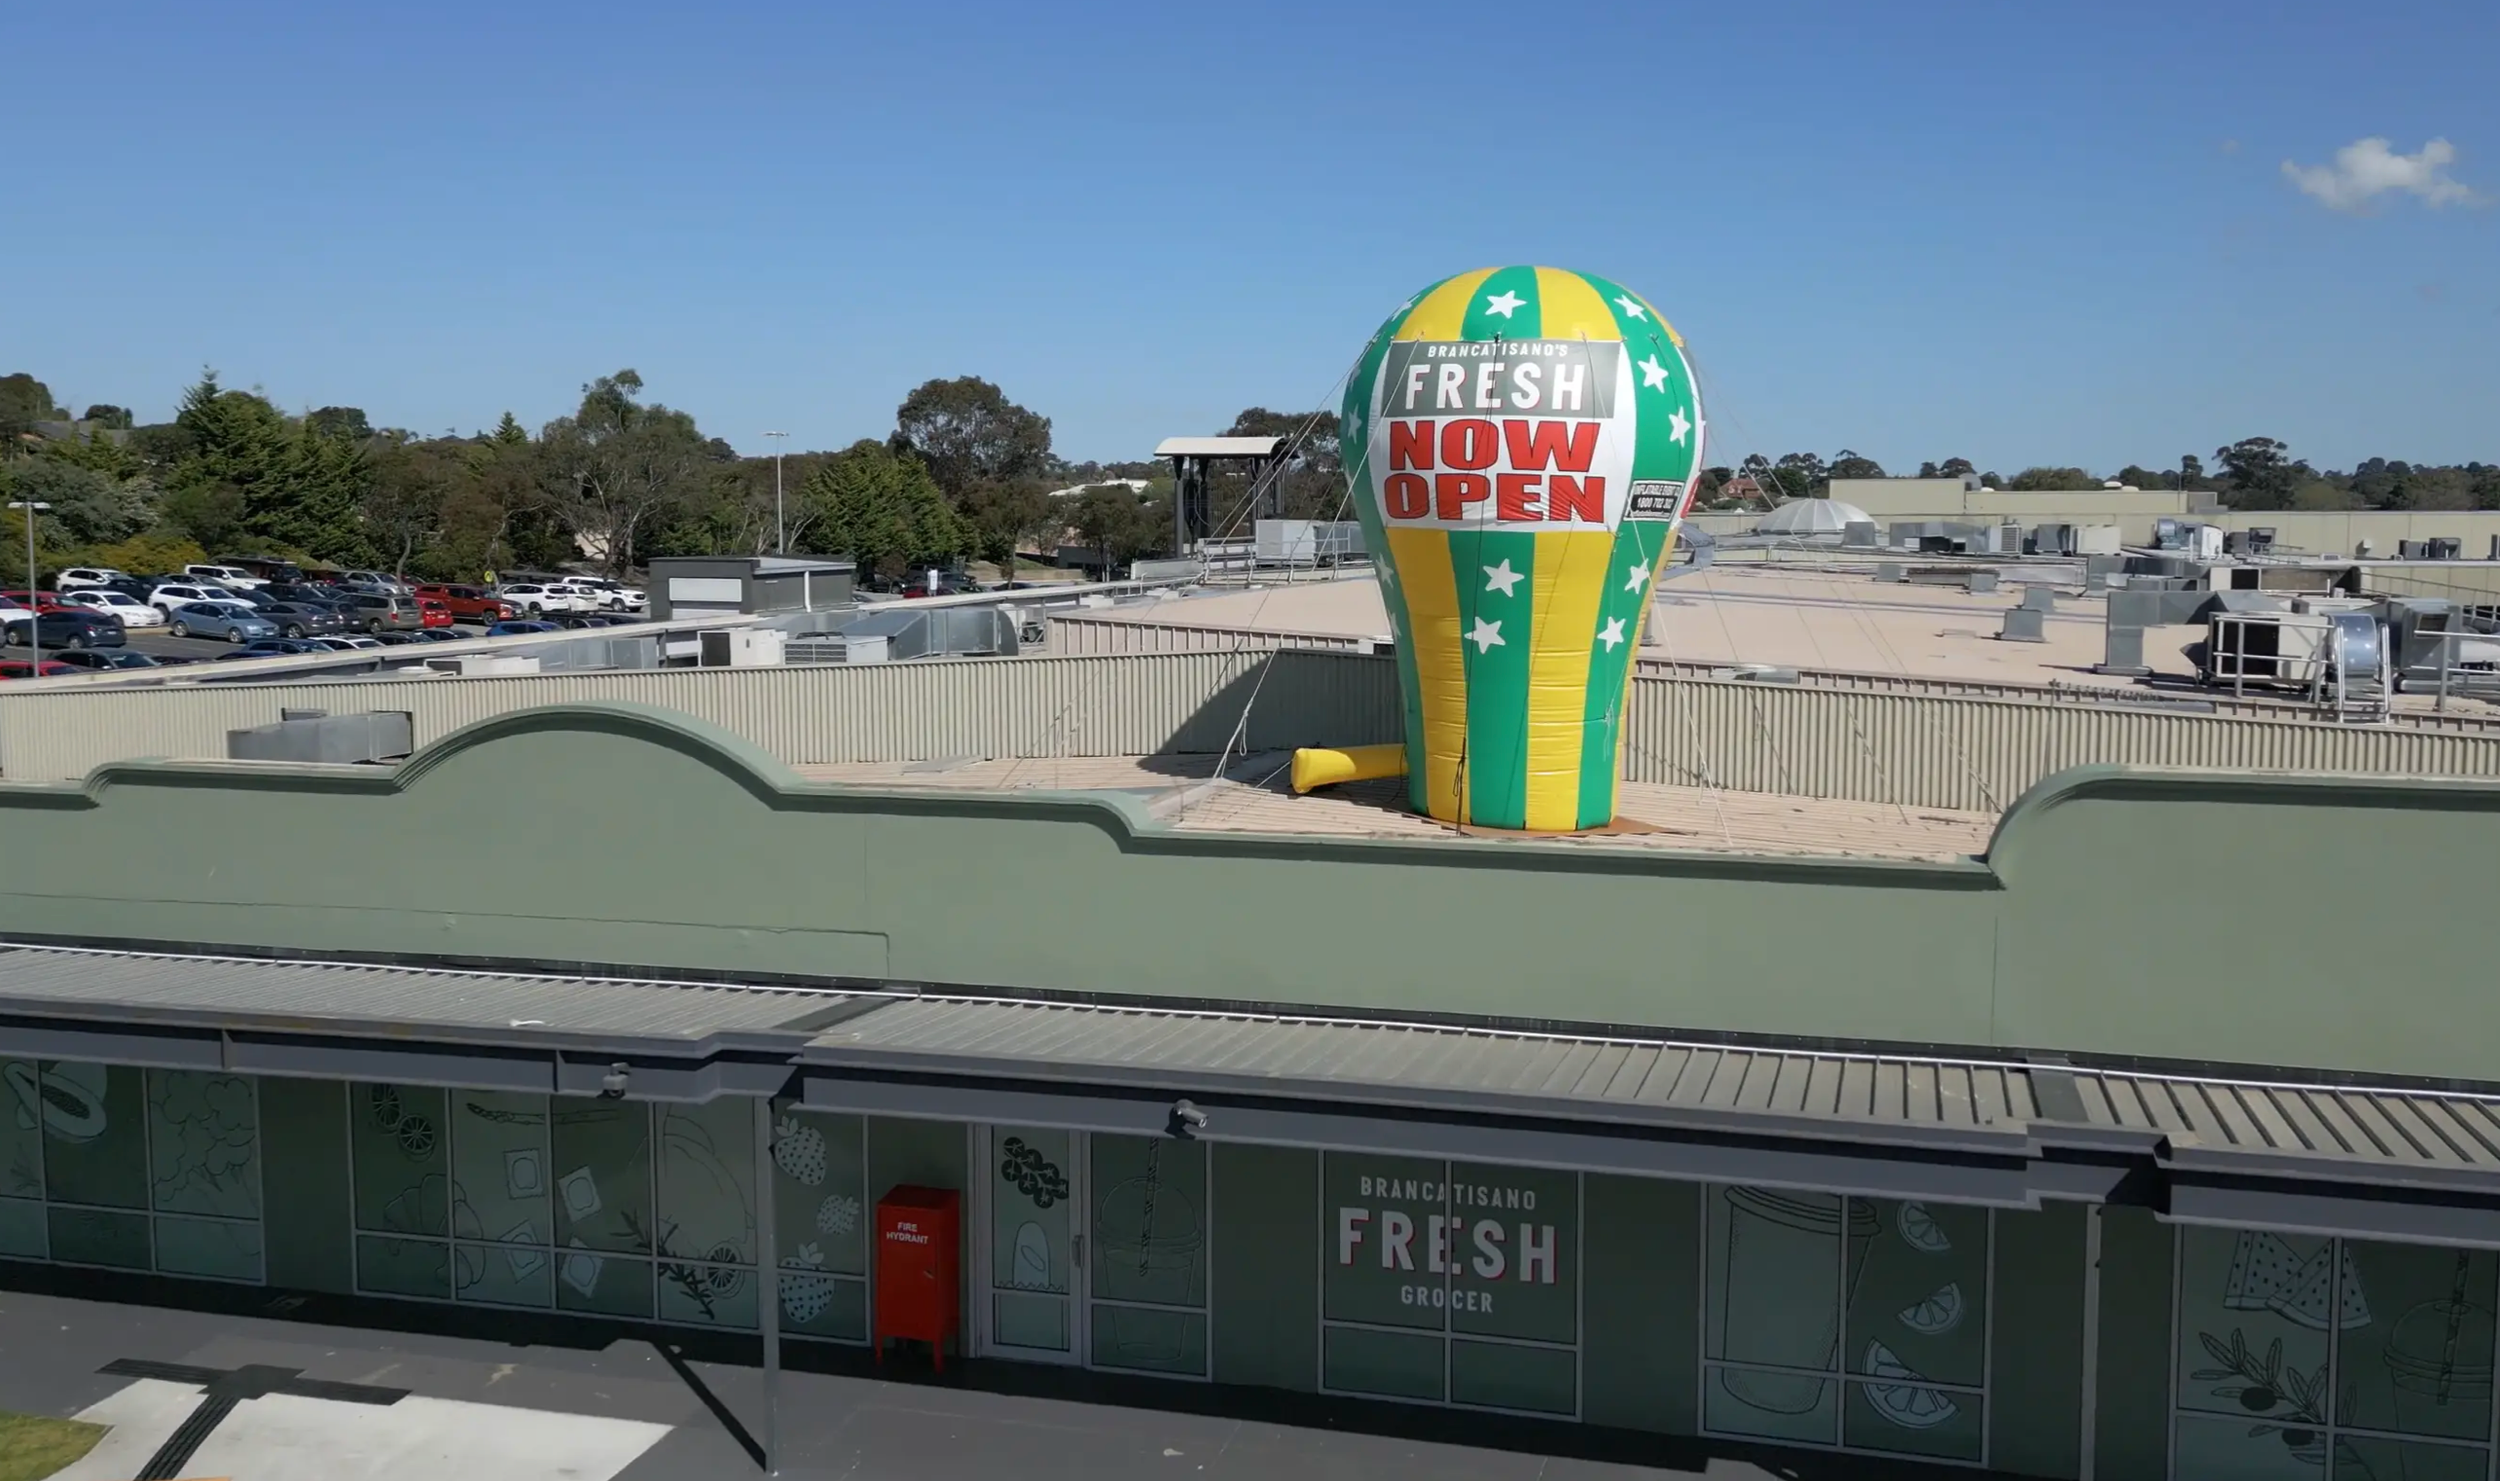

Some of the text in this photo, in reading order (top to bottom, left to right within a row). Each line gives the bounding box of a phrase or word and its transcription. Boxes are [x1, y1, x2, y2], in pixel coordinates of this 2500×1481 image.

[1427, 342, 1569, 358] BRANCATISANO'S
[1405, 362, 1586, 411] FRESH
[1389, 418, 1601, 473] NOW
[1384, 473, 1606, 523] OPEN
[1360, 1175, 1536, 1210] BRANCATISANO
[886, 1231, 929, 1244] HYDRANT
[897, 1222, 918, 1232] FIRE
[1339, 1206, 1557, 1285] FRESH
[1401, 1285, 1493, 1313] GROCER
